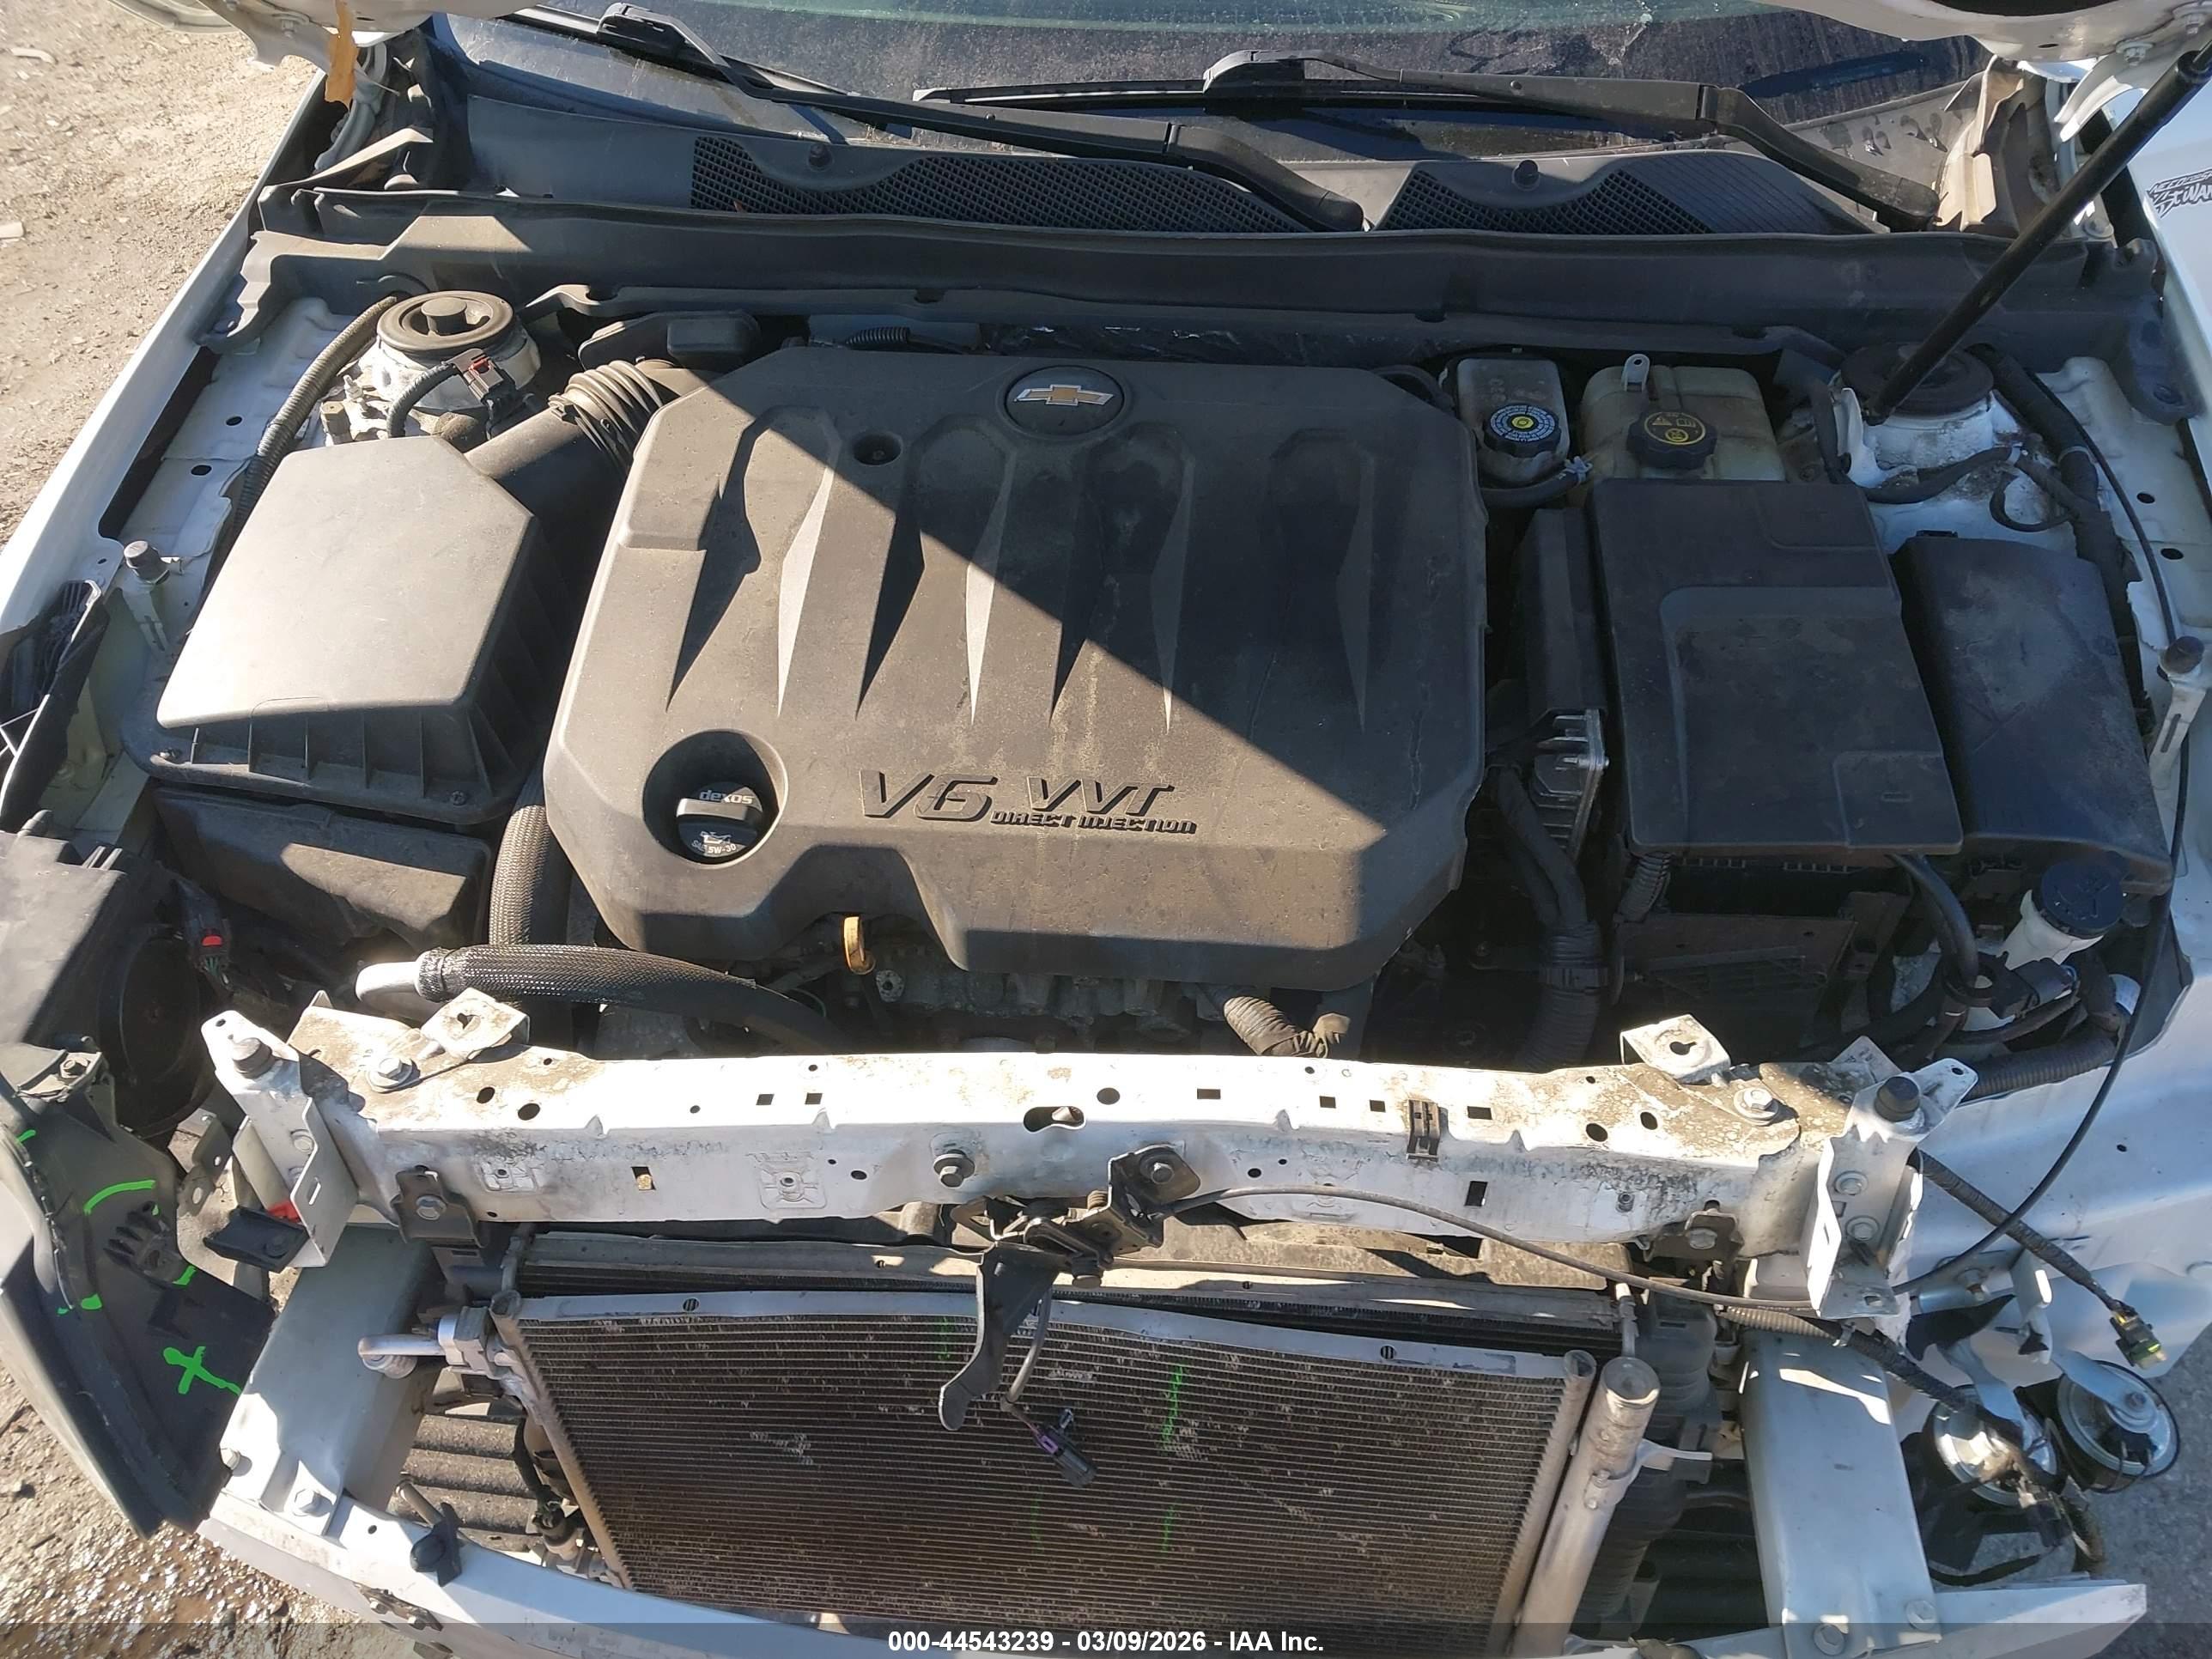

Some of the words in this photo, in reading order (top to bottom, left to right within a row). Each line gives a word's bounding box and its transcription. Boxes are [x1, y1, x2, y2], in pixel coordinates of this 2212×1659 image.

[699, 790, 755, 805] dexos
[859, 770, 998, 822] V6
[1027, 775, 1175, 816] VVT
[990, 810, 1075, 828] DIRECT
[1078, 814, 1197, 835] INJECTION
[691, 840, 708, 853] SAE
[707, 844, 737, 854] 5W-30
